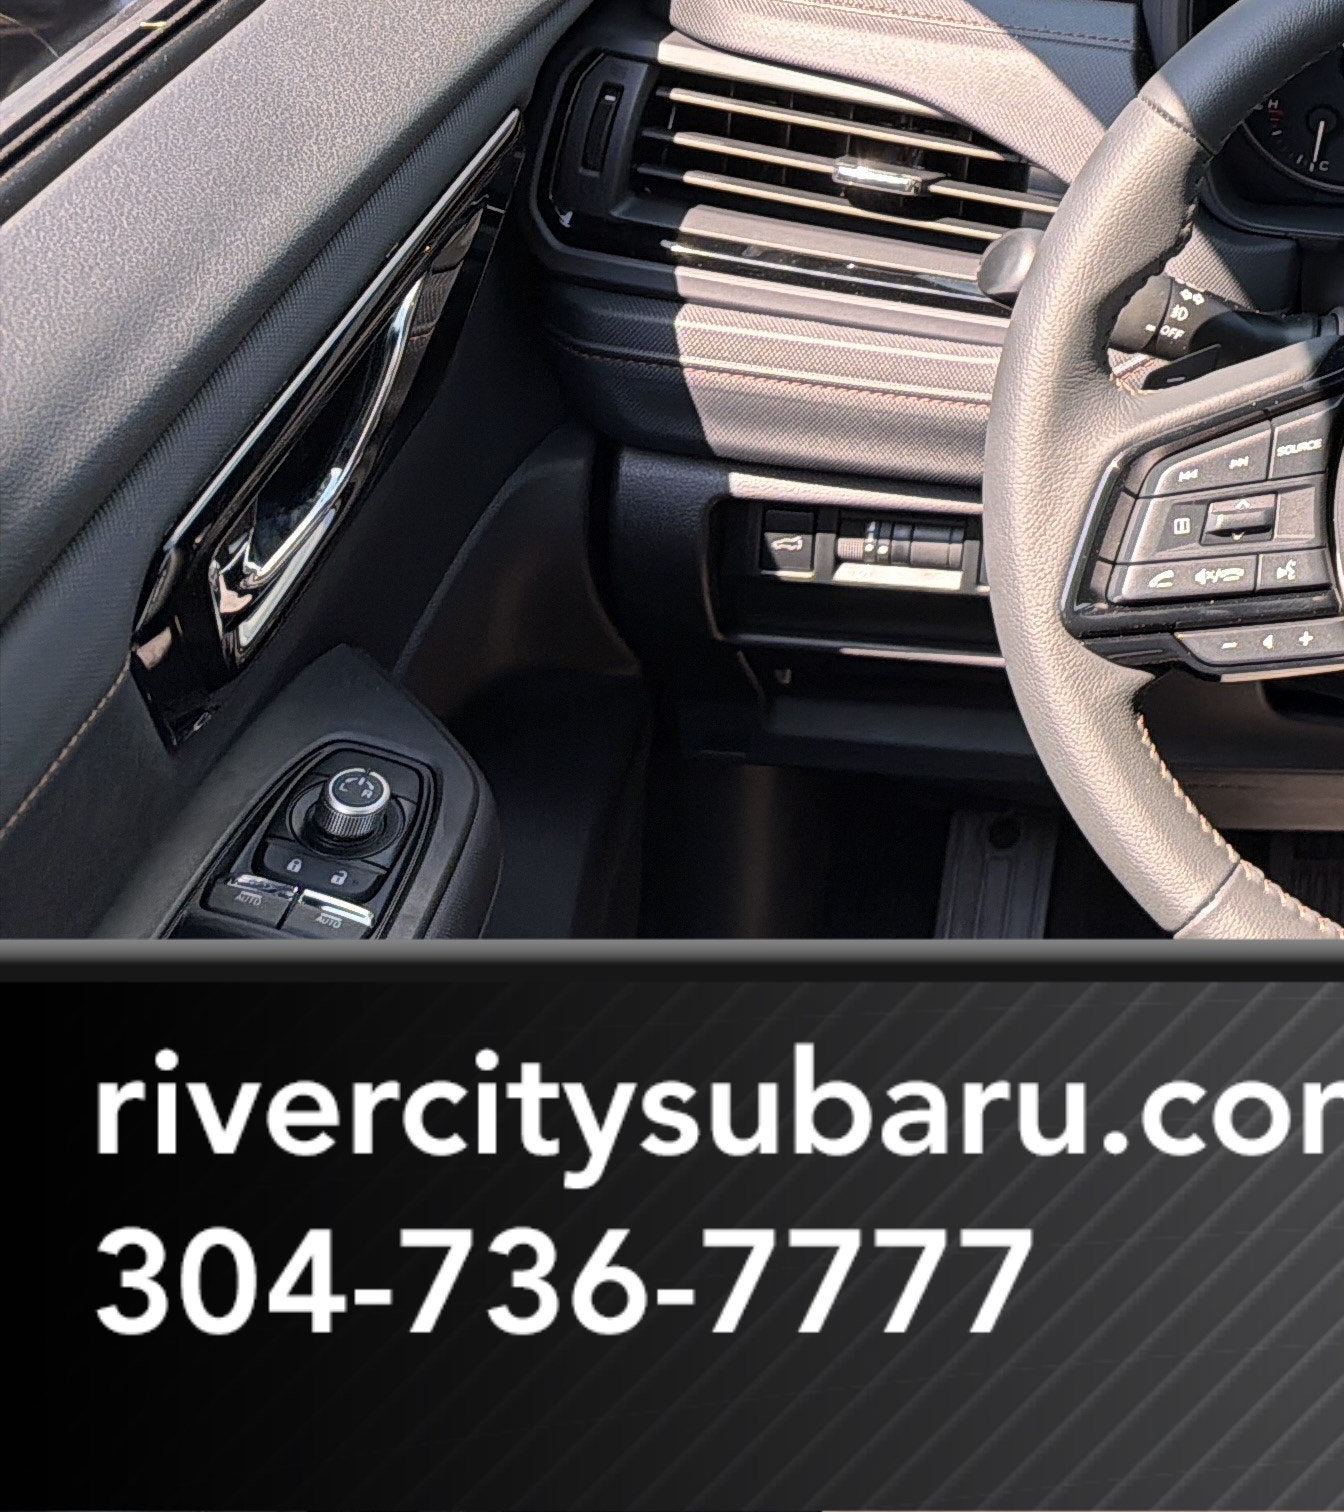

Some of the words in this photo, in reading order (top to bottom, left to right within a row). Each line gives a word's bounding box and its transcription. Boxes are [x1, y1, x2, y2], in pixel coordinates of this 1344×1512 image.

[1319, 161, 1329, 172] C
[1159, 324, 1185, 339] OFF
[1276, 438, 1323, 458] SOURCE
[235, 893, 262, 906] AUTO
[315, 915, 342, 929] AUTO
